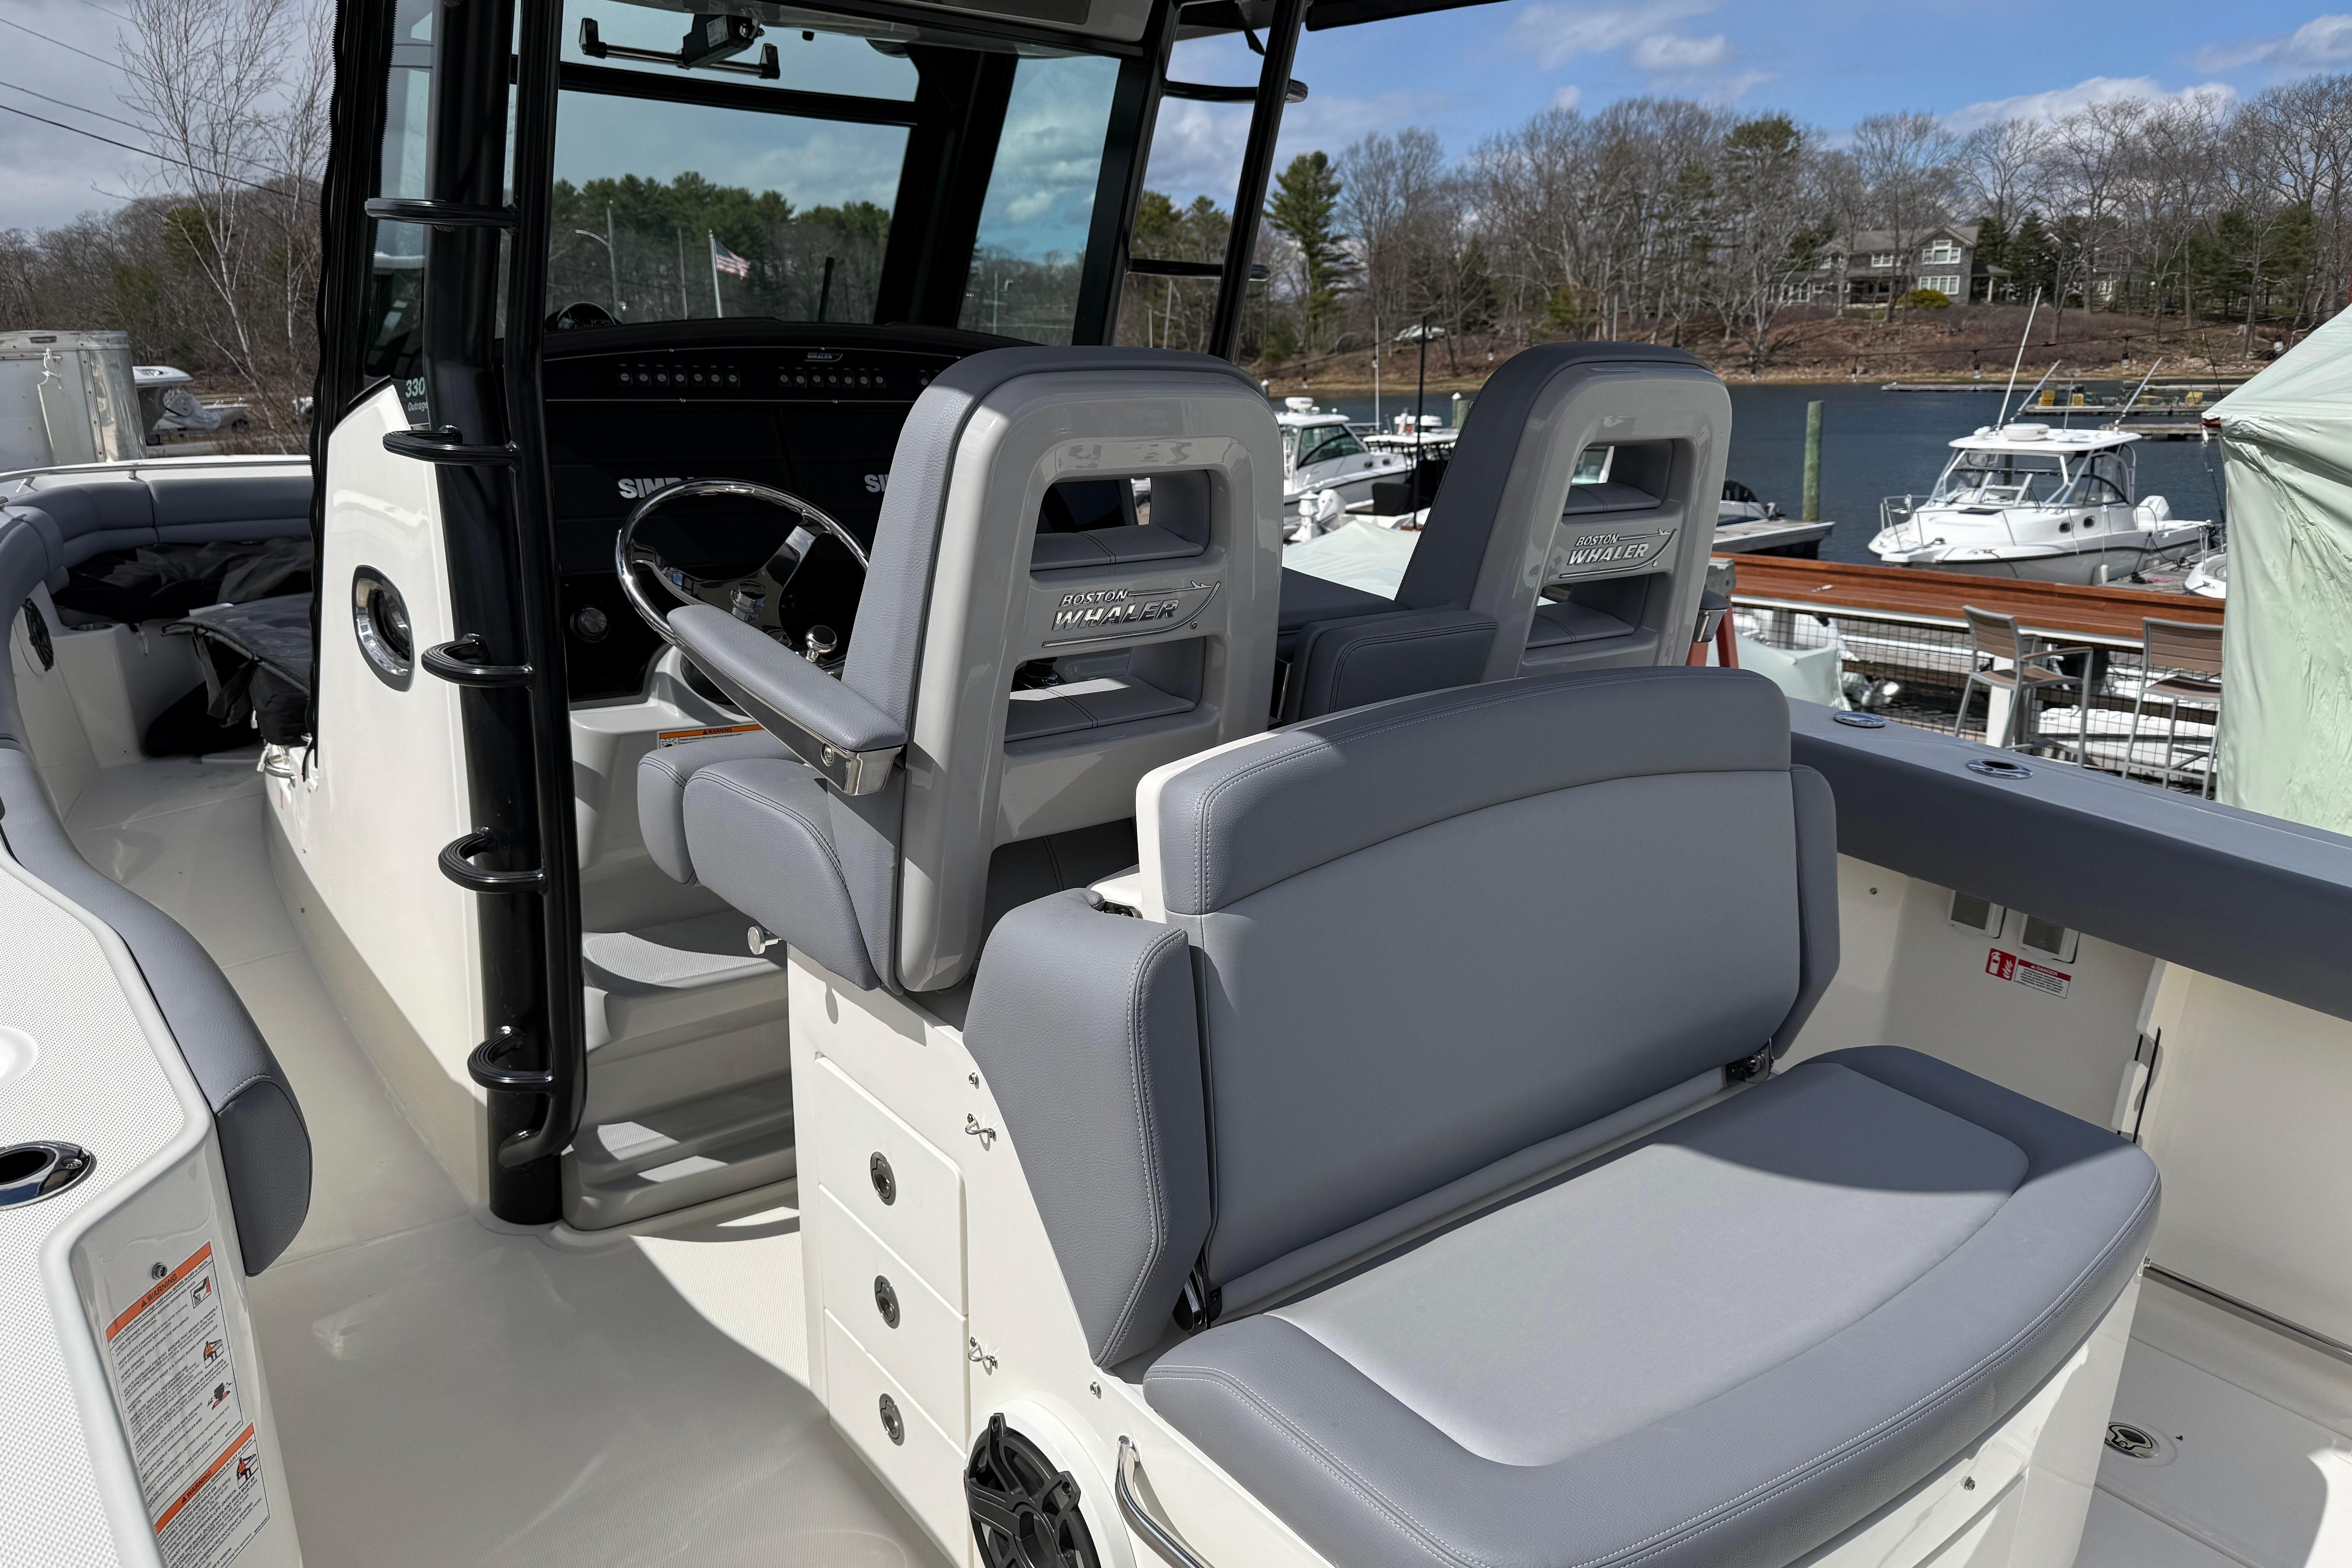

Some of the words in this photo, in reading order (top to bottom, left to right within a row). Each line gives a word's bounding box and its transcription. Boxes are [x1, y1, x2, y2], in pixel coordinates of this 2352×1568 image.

[405, 377, 425, 398] 330
[408, 401, 428, 411] Outrage
[1575, 533, 1620, 547] BOSTON
[1567, 543, 1649, 565] WHALER
[1059, 589, 1130, 608] BOSTON
[1052, 599, 1180, 631] WHALER
[2036, 966, 2058, 977] DANGER
[147, 1272, 177, 1303] WARNING
[187, 1469, 212, 1498] WARNING
